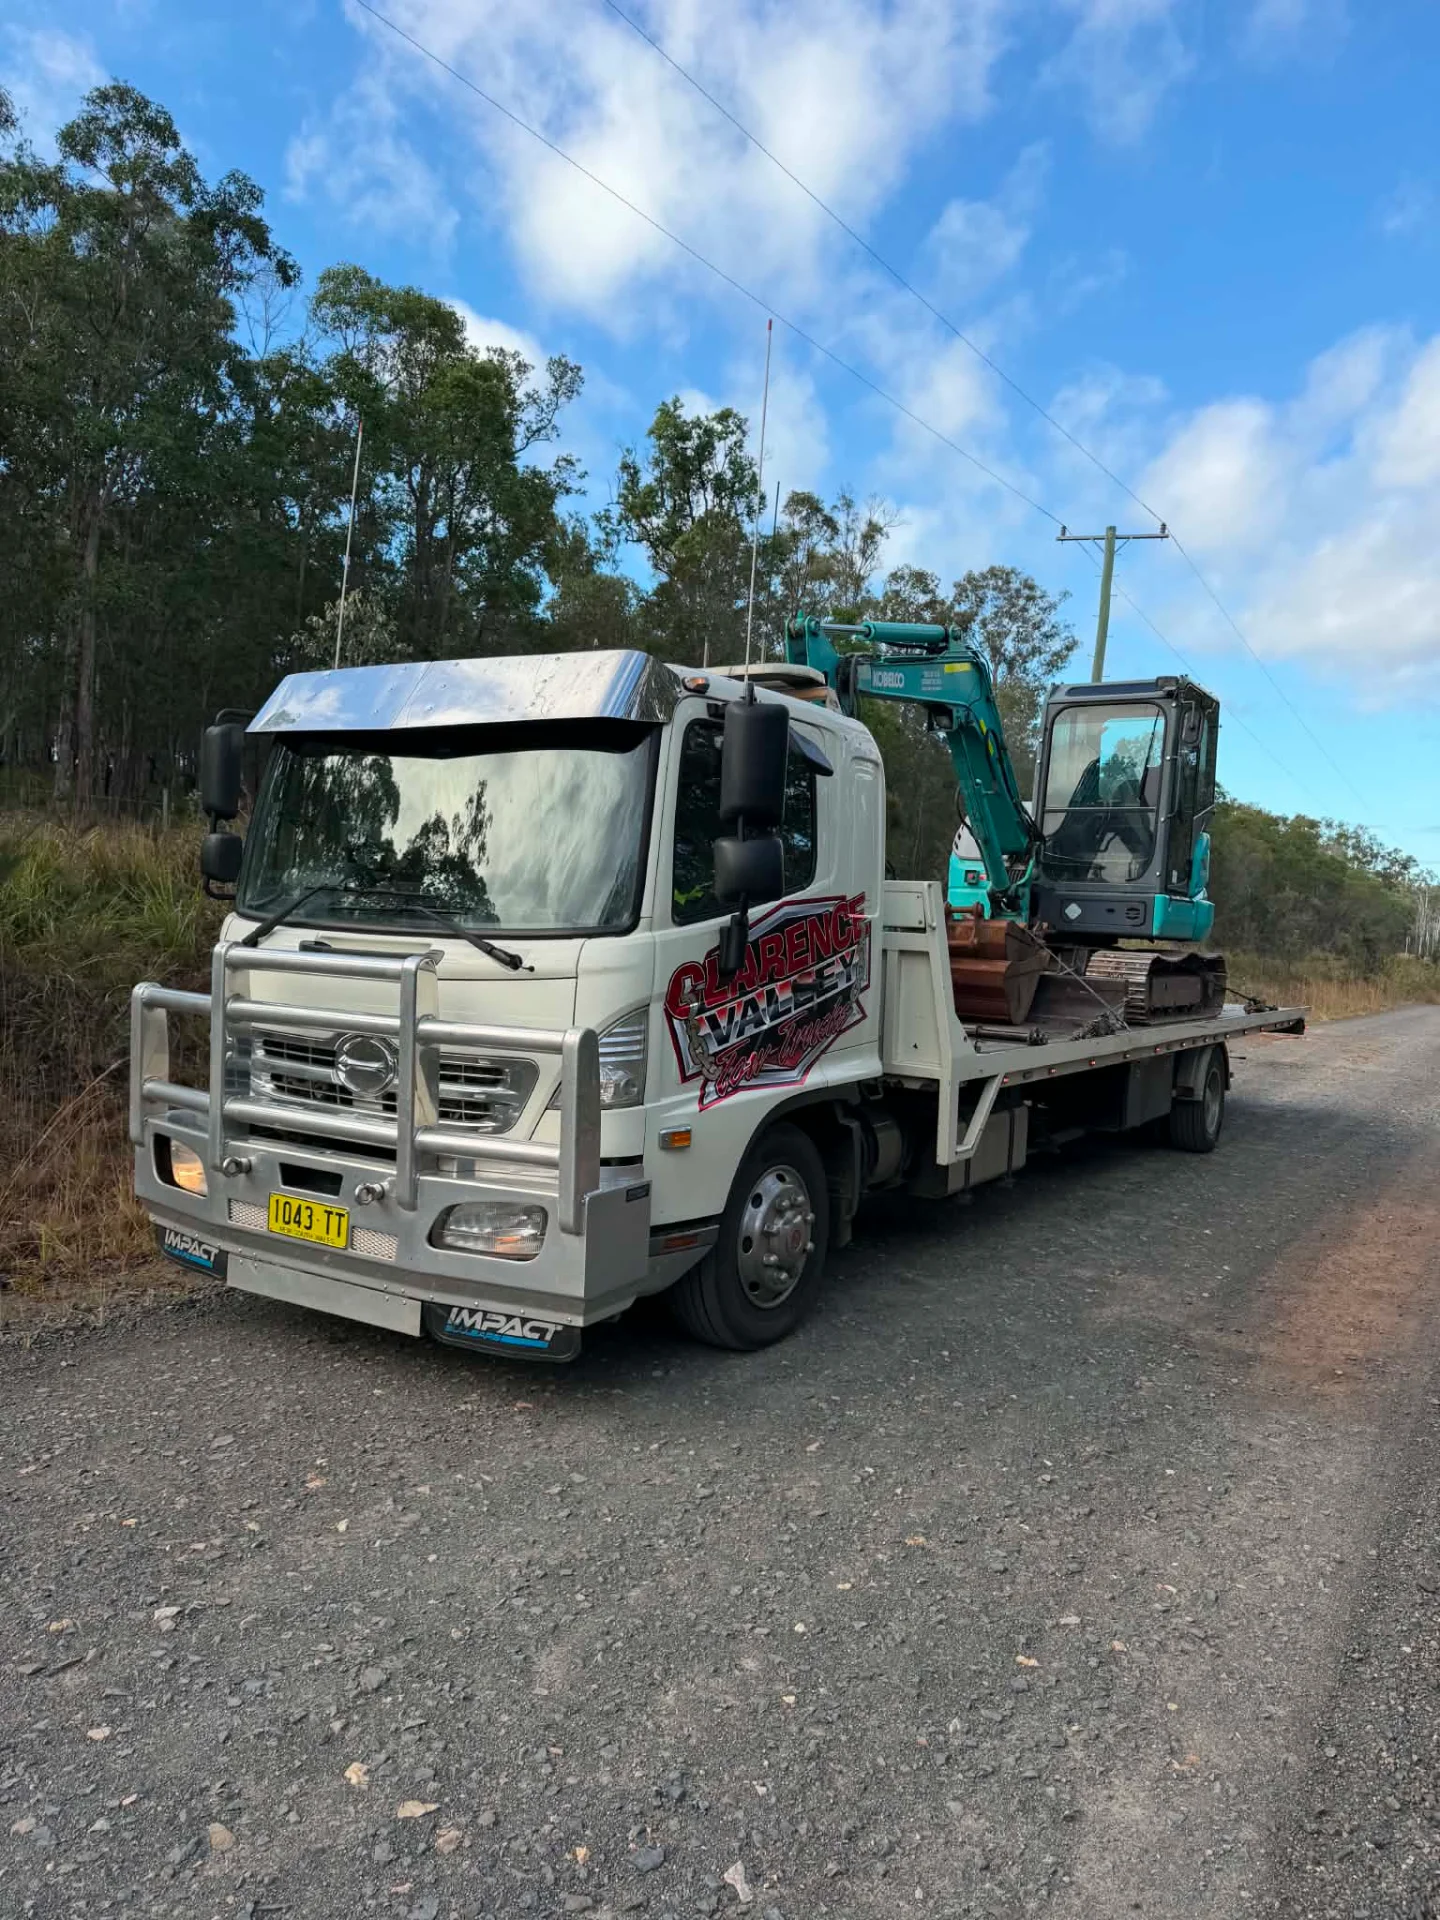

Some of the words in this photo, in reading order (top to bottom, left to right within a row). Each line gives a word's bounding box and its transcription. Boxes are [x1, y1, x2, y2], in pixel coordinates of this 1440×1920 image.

[872, 670, 905, 689] KOBELCO
[666, 891, 870, 1020] CLARENCE
[700, 949, 858, 1048] VALLEY
[274, 1198, 313, 1231] 1043
[324, 1209, 346, 1238] TT
[164, 1229, 219, 1263] IMPACT
[450, 1307, 564, 1342] IMPACT
